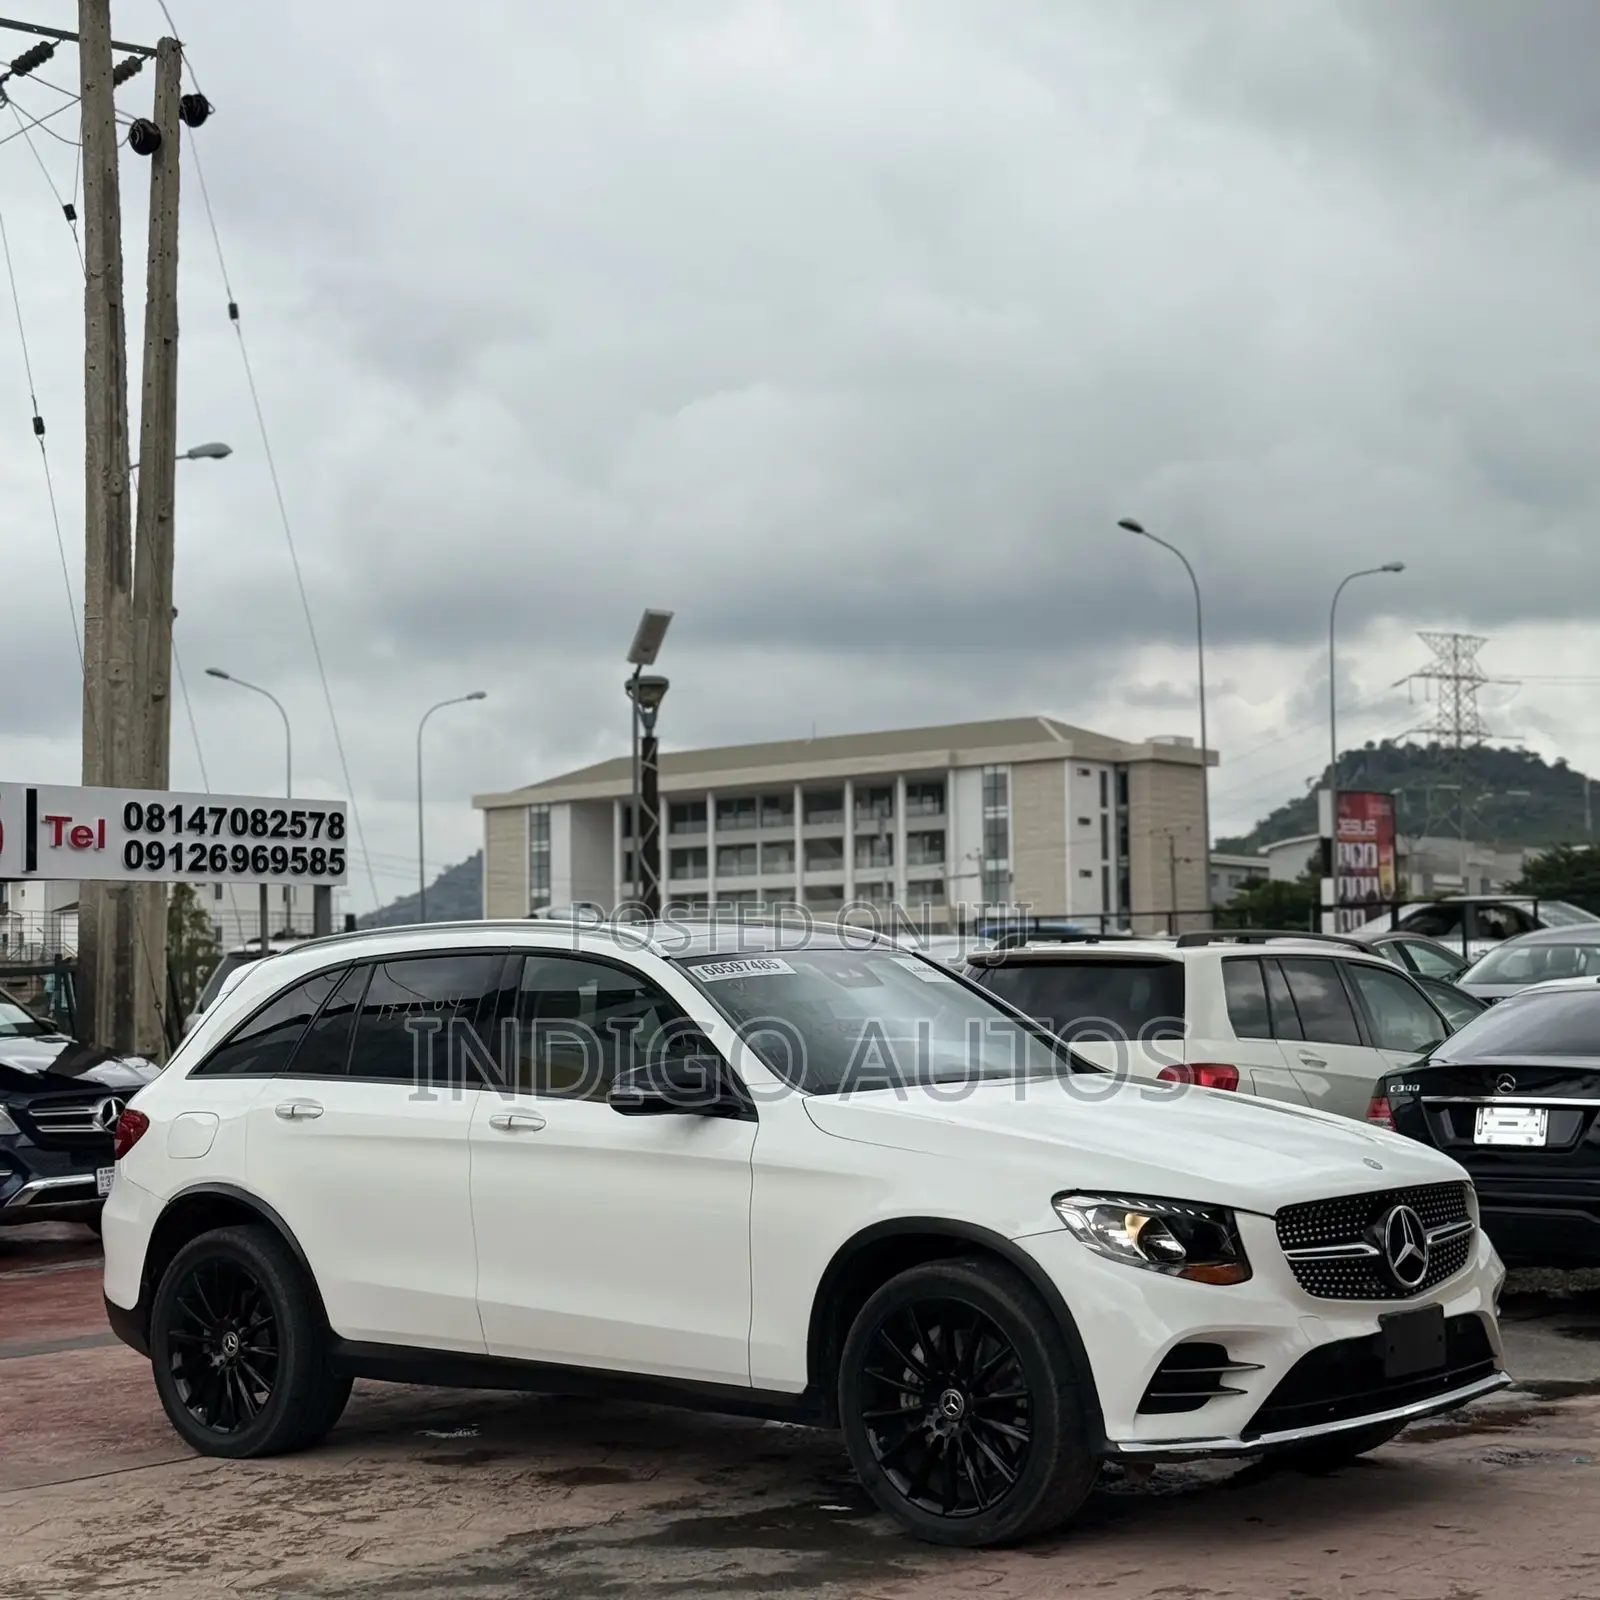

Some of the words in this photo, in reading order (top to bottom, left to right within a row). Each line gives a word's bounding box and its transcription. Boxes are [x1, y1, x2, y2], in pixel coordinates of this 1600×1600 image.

[44, 814, 106, 849] Tel
[123, 801, 345, 841] 08147082578
[123, 839, 345, 876] 09126969585
[701, 959, 780, 976] 66597485
